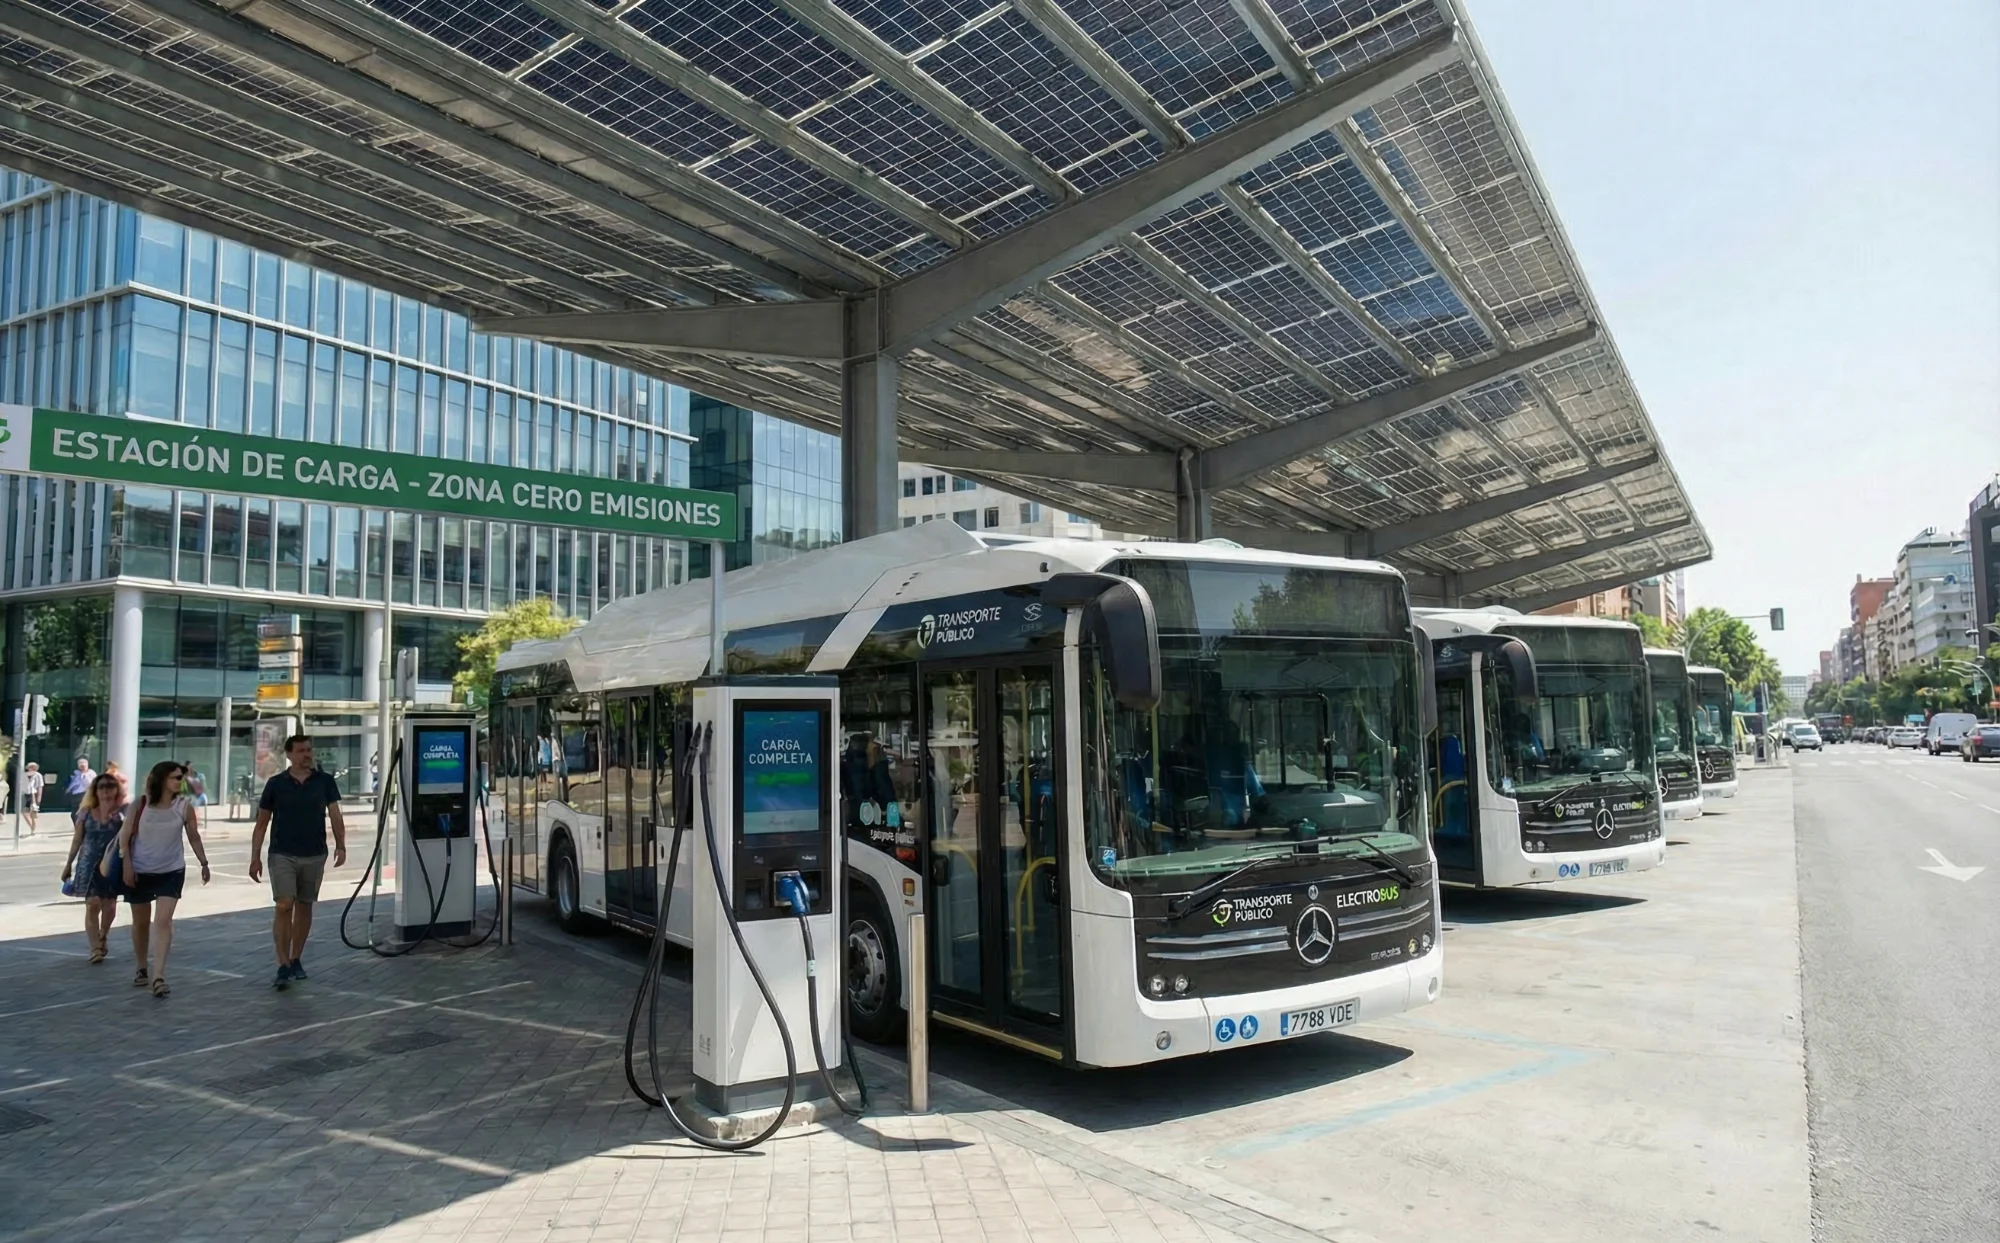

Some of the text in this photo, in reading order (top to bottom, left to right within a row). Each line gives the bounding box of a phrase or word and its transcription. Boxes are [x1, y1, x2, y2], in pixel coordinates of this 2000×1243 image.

[52, 427, 230, 474] ESTACIÓN
[242, 450, 285, 480] DE
[294, 456, 400, 493] CARGA
[427, 471, 505, 504] ZONA
[512, 482, 582, 512] CERO
[590, 491, 721, 527] EMISIONES
[938, 606, 1002, 628] TRANSPORTE
[936, 627, 975, 643] PÚBLICO
[761, 739, 801, 751] CARGA
[748, 752, 813, 765] COMPLETA
[1233, 893, 1293, 910] TRANSPORTE
[1336, 885, 1399, 908] ELECTROBUS
[1291, 1003, 1353, 1033] 7788 VDE
